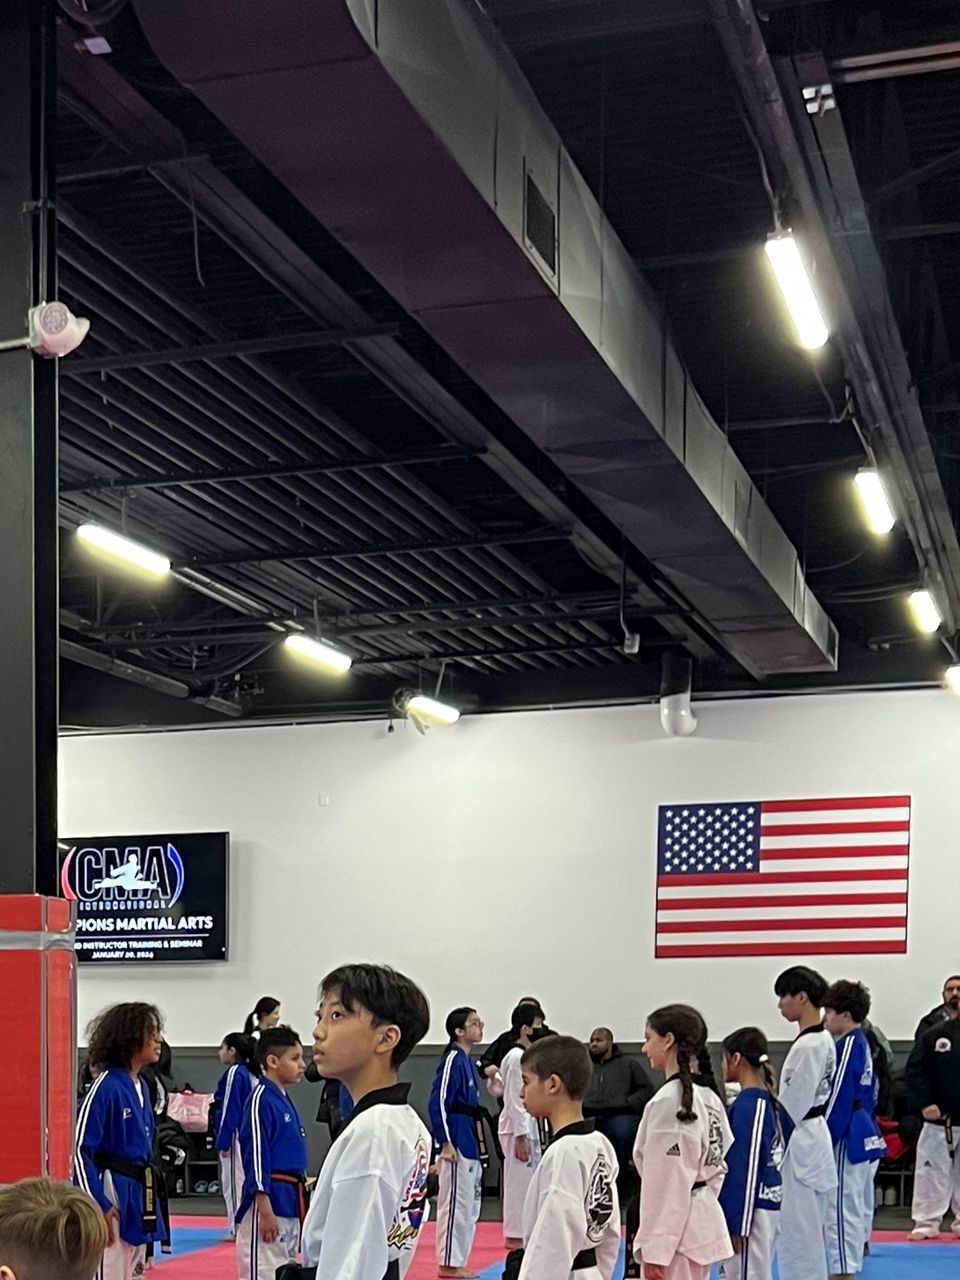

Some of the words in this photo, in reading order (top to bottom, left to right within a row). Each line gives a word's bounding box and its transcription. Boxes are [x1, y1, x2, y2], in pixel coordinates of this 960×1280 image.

[76, 846, 171, 901] CMA
[116, 916, 176, 931] MARTIAL
[177, 915, 213, 930] ARTS
[83, 941, 128, 950] INSTRUCTOR
[128, 940, 162, 949] TRAINING
[92, 951, 124, 959] JANUARY
